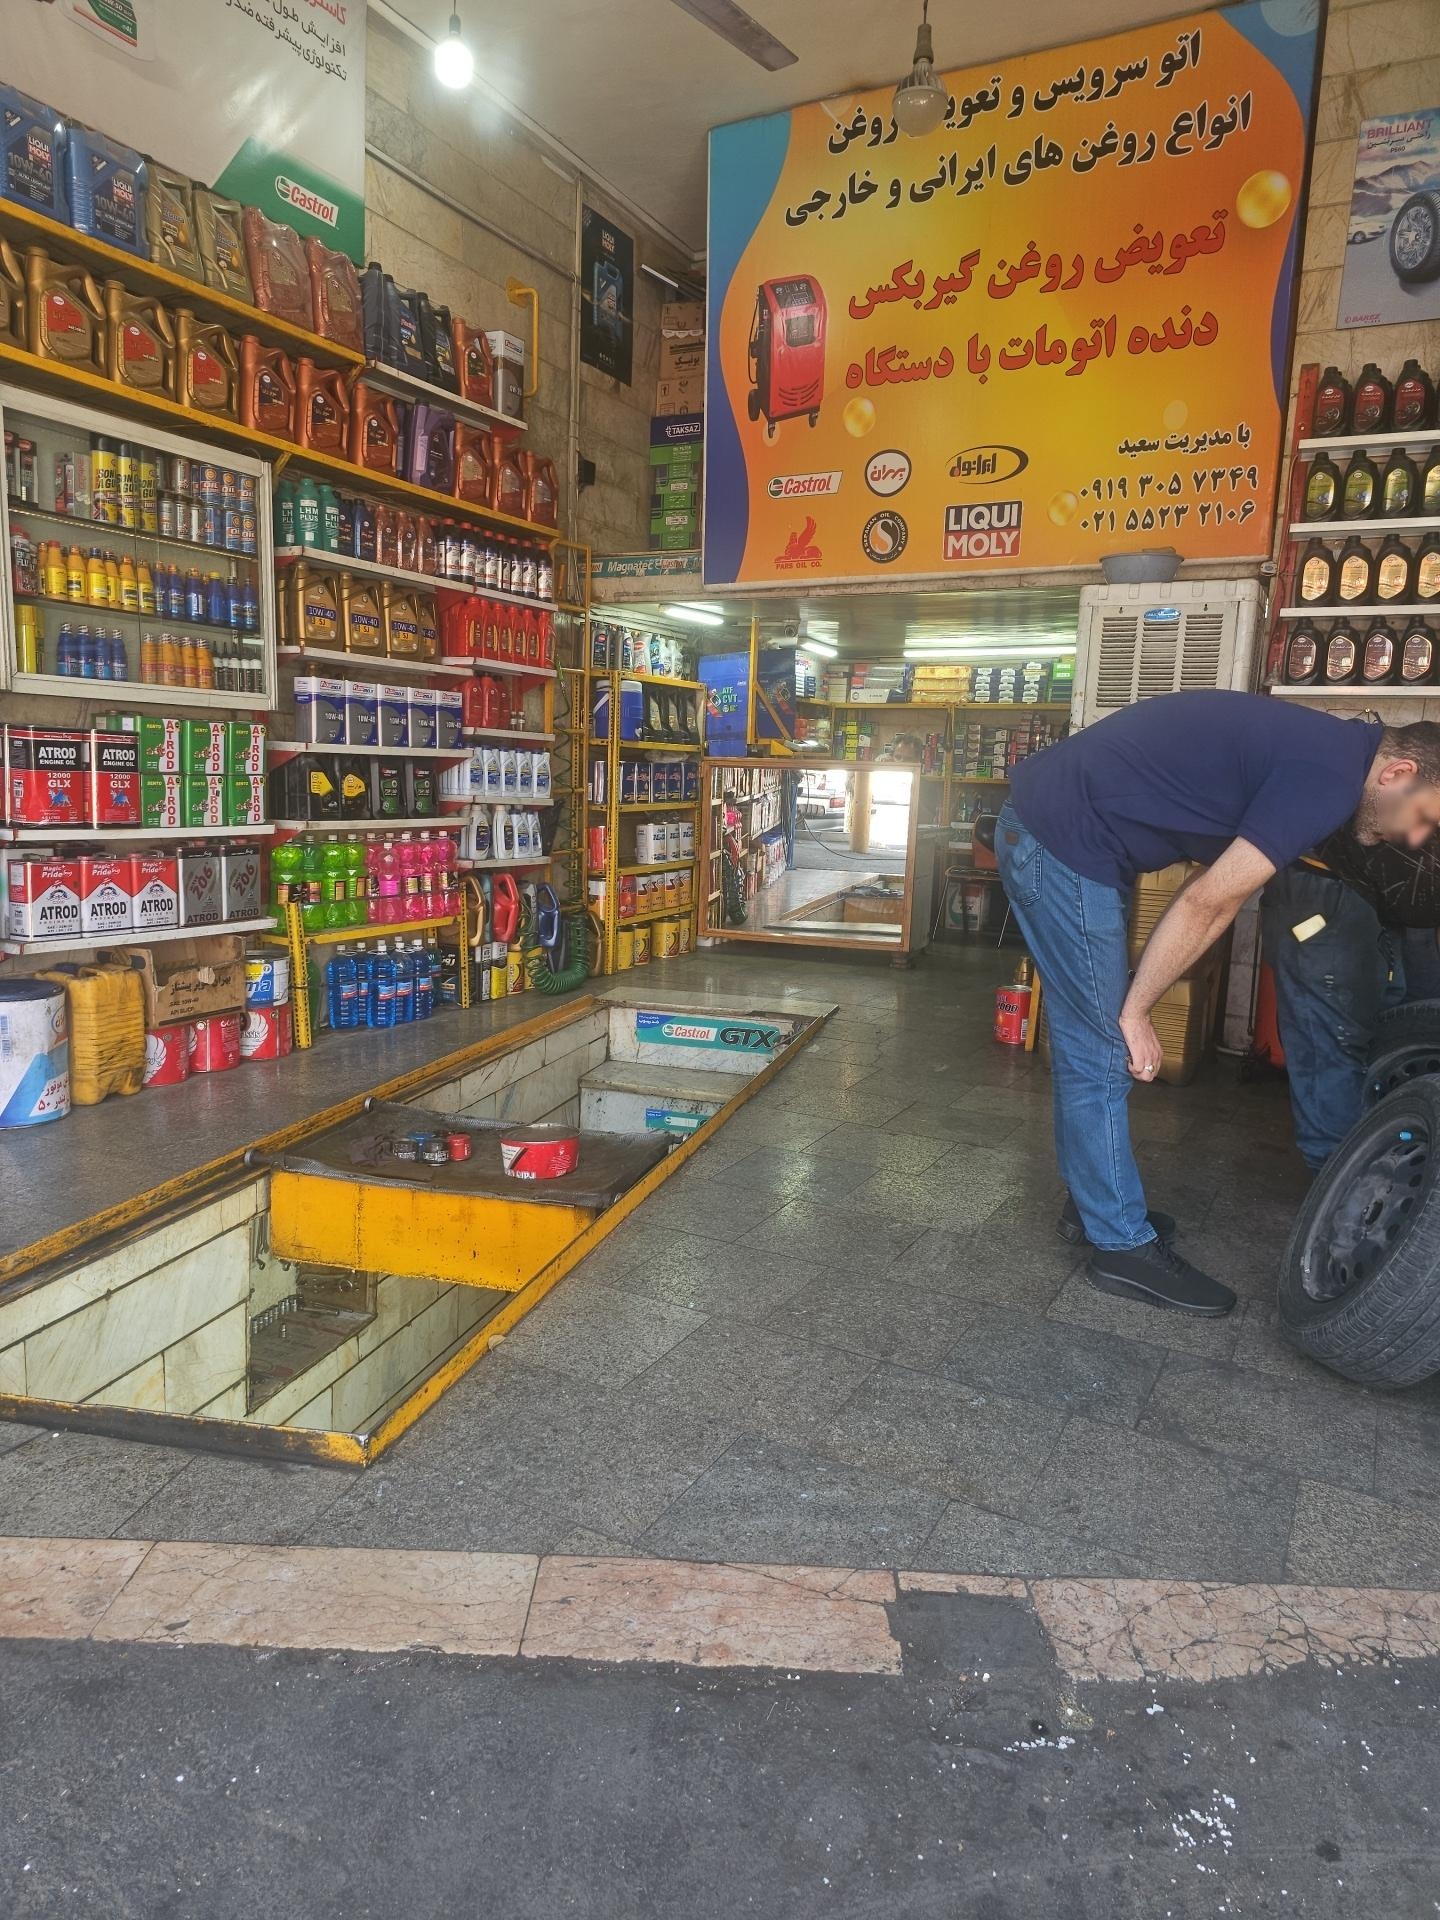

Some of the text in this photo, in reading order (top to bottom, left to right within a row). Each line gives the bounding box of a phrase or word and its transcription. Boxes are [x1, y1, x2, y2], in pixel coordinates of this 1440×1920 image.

[255, 13, 347, 81] تکنولوژی پیشرفته
[302, 21, 346, 56] افزایش
[826, 29, 1202, 154] اتو سرویس و تعوی روغن
[1367, 119, 1433, 139] BRILLIANT
[784, 91, 1252, 228] انواع روغن های ایرانی و خارجی
[290, 186, 335, 223] Castrol
[848, 209, 1229, 319] تعویض روغن گیربکس
[845, 304, 1219, 389] دنده اتومات با دستگاه
[671, 424, 699, 436] TAKSAZ
[1117, 421, 1251, 458] با مدیریت سعید
[870, 464, 906, 481] بهران
[948, 452, 997, 478] ایرانول
[783, 474, 833, 495] Castrol
[1080, 465, 1259, 501] ۰۹۱۹ ۳۰۵ ۷۳۴۹
[300, 506, 319, 515] LHM
[300, 514, 319, 522] PLUS
[947, 503, 1018, 532] LIQUI
[1080, 498, 1256, 533] ۰۲۱ ۵۵۲۳ ۲۱۰۶
[863, 516, 877, 548] SEPAHAN
[893, 515, 906, 545] COMPANY
[946, 531, 1018, 559] MOLY
[796, 561, 808, 569] OIL
[308, 605, 335, 619] 10W-40
[353, 614, 378, 627] 10W-40
[393, 621, 416, 633] 10W-40
[39, 746, 77, 759] ATROD
[102, 748, 136, 761] ATROD
[166, 720, 175, 770] ATROD
[211, 723, 220, 772] ATROD
[251, 725, 260, 772] ATROD
[47, 779, 71, 788] GLX
[110, 780, 131, 789] GLX
[166, 776, 176, 825] ATROD
[209, 777, 219, 824] ATROD
[252, 776, 261, 822] ATROD
[191, 861, 213, 901] 206
[234, 859, 255, 897] 206
[40, 904, 79, 921] ATROD
[90, 901, 127, 917] ATROD
[140, 898, 174, 914] ATROD
[187, 912, 219, 924] ATROD
[229, 907, 260, 919] ATROD
[674, 1025, 778, 1049] Castrol GTX
